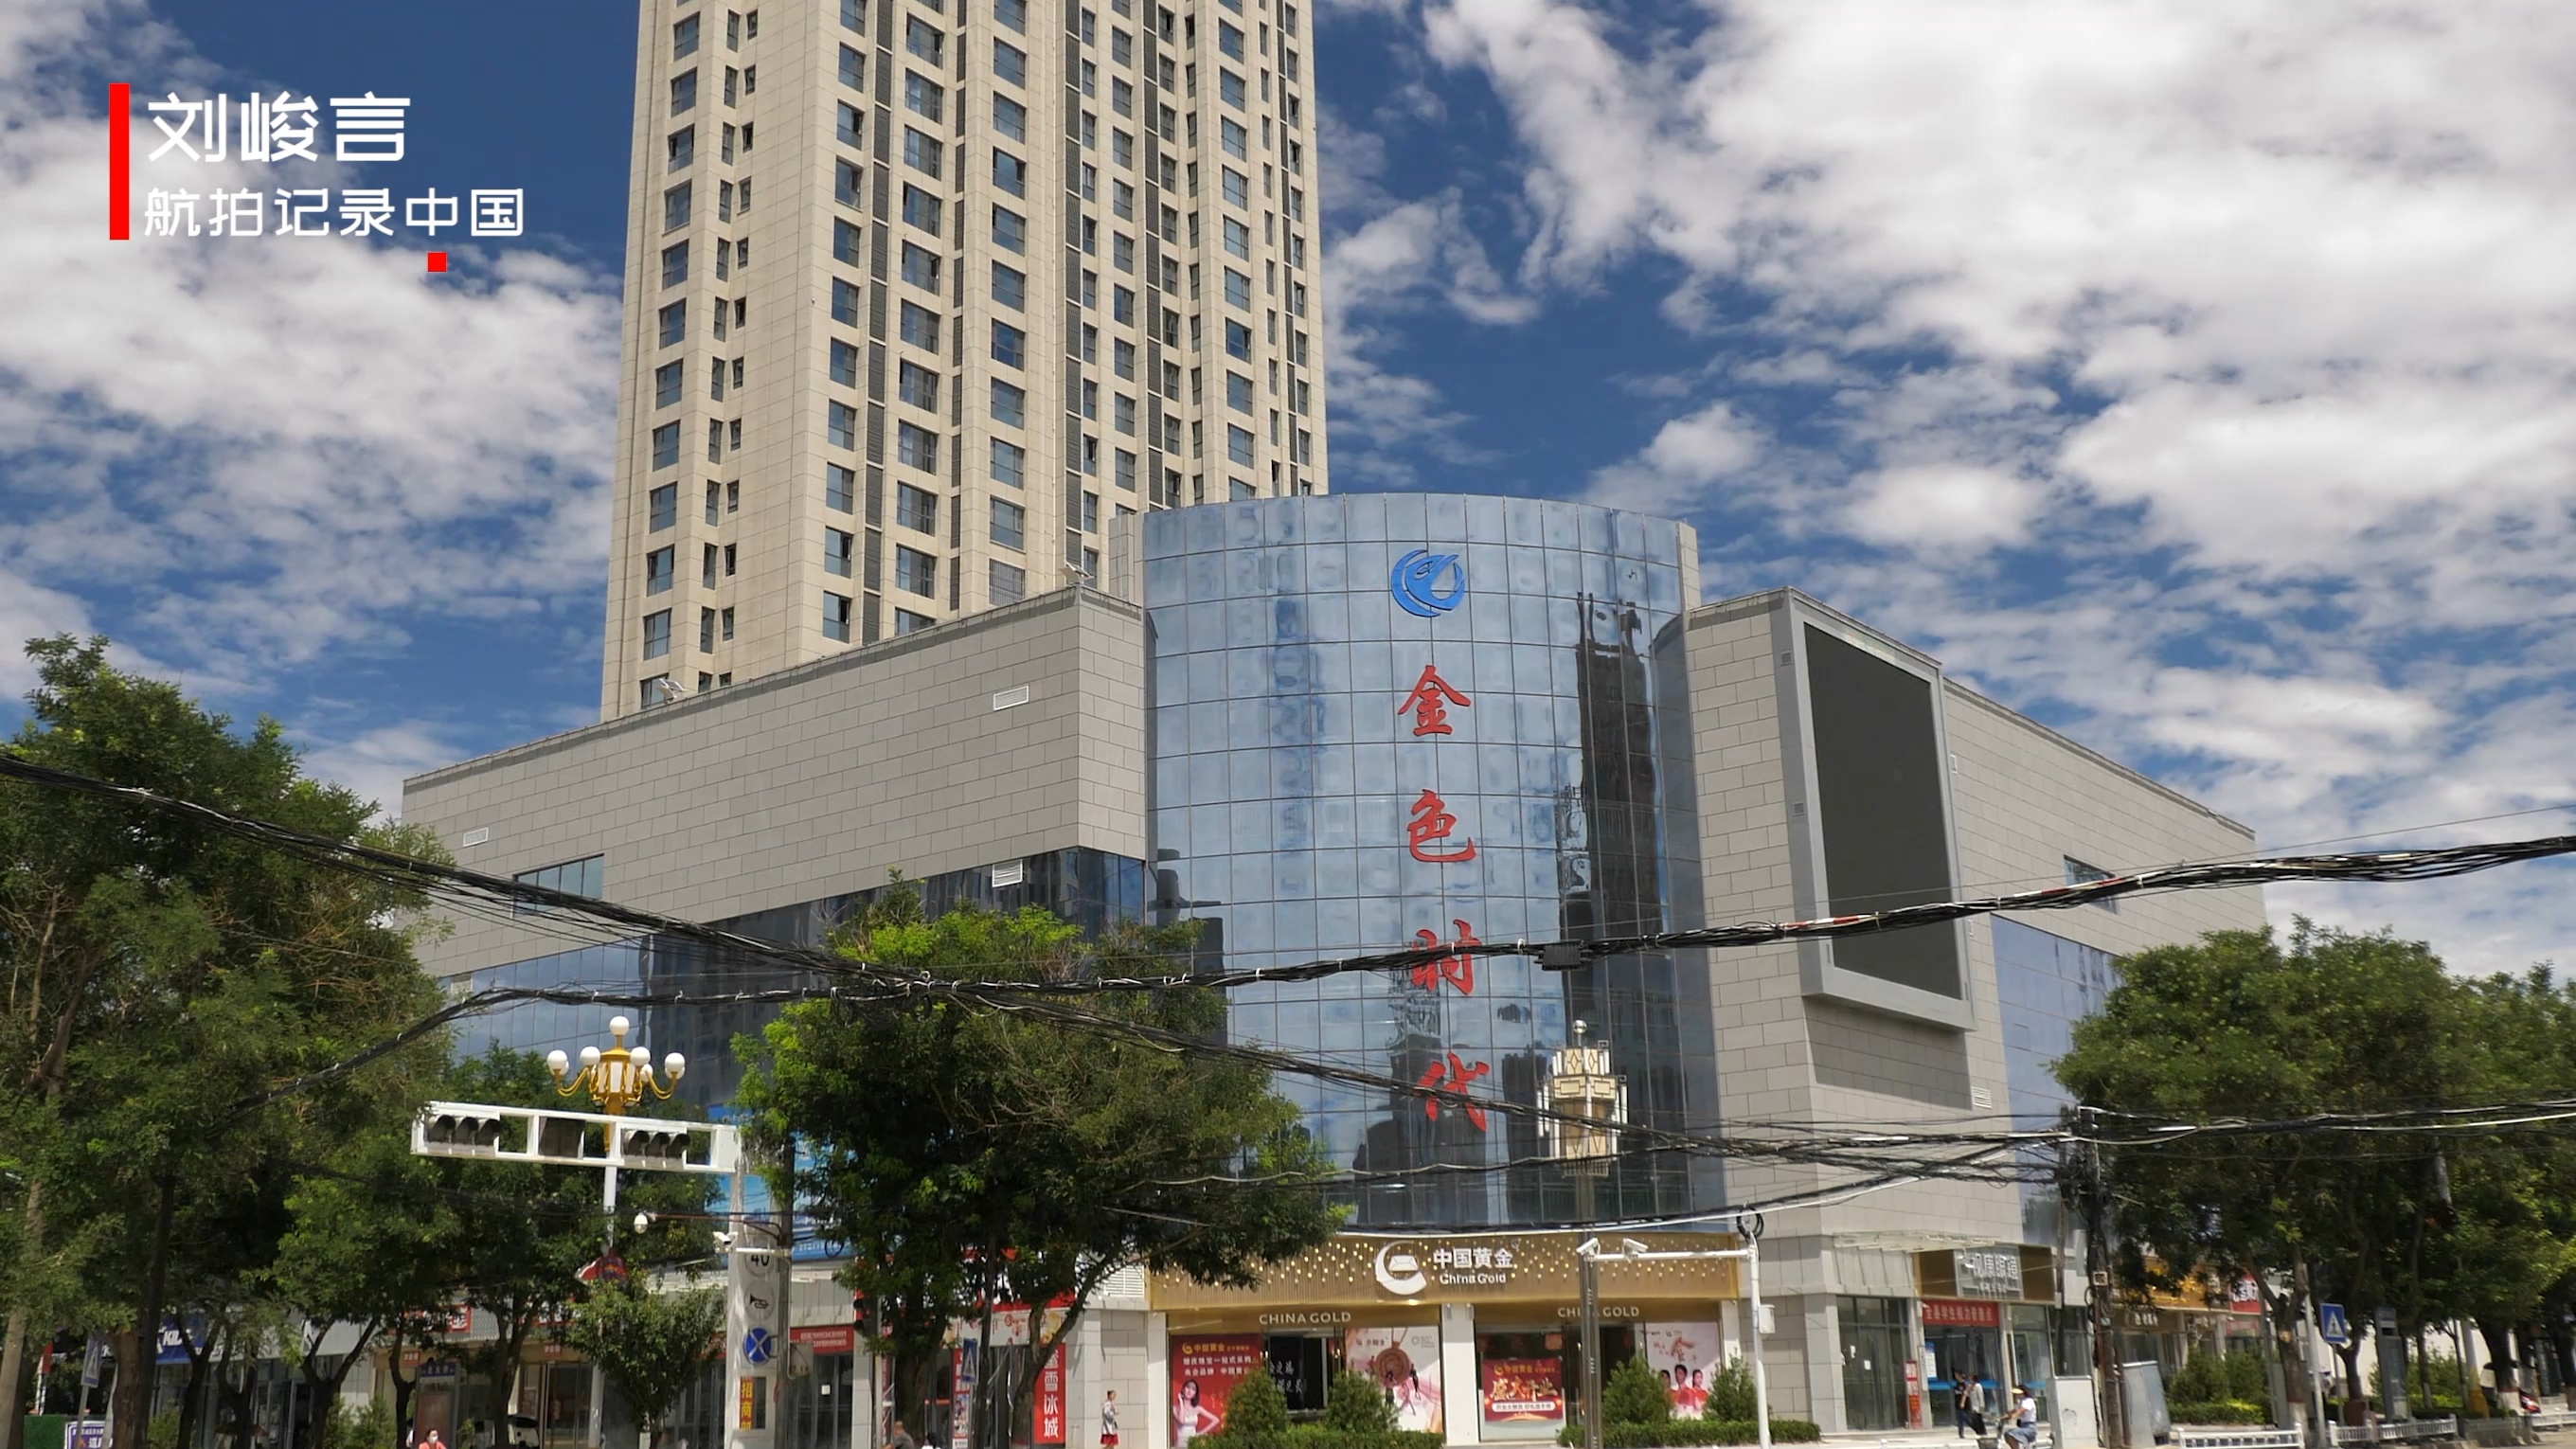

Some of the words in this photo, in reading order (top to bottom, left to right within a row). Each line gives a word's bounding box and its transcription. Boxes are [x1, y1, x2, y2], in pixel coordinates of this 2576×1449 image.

[1397, 664, 1491, 1134] 金色时代
[1432, 1246, 1513, 1270] 中国黄金
[1440, 1273, 1476, 1285] China
[1477, 1273, 1507, 1284] Gold
[1259, 1313, 1307, 1325] CHINA
[1310, 1312, 1351, 1324] GOLD
[1558, 1307, 1601, 1318] CHI
[1602, 1306, 1640, 1318] GOLD
